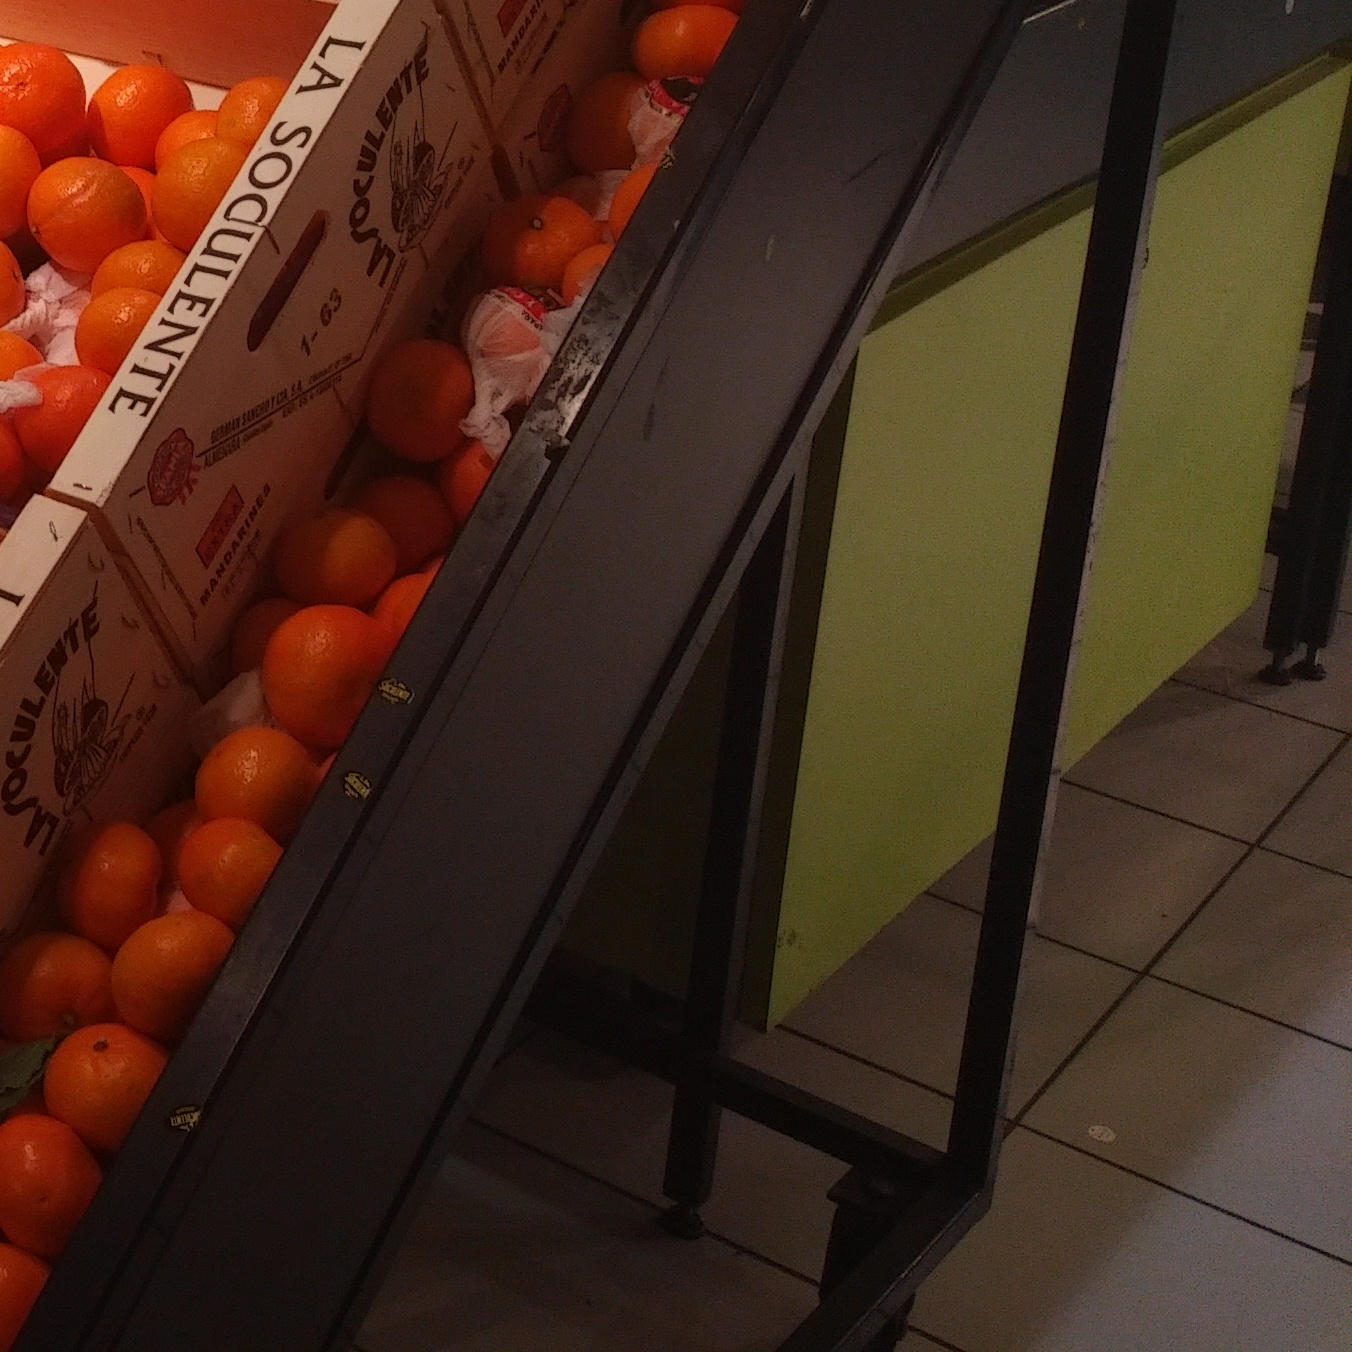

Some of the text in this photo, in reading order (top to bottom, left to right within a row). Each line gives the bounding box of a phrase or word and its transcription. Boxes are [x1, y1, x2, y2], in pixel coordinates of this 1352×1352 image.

[296, 34, 367, 96] LA
[349, 28, 430, 288] LA SOCULENTE
[108, 120, 313, 418] SOCULENTE
[199, 483, 271, 607] MANDARINES
[0, 584, 101, 856] LA SOCULENTE
